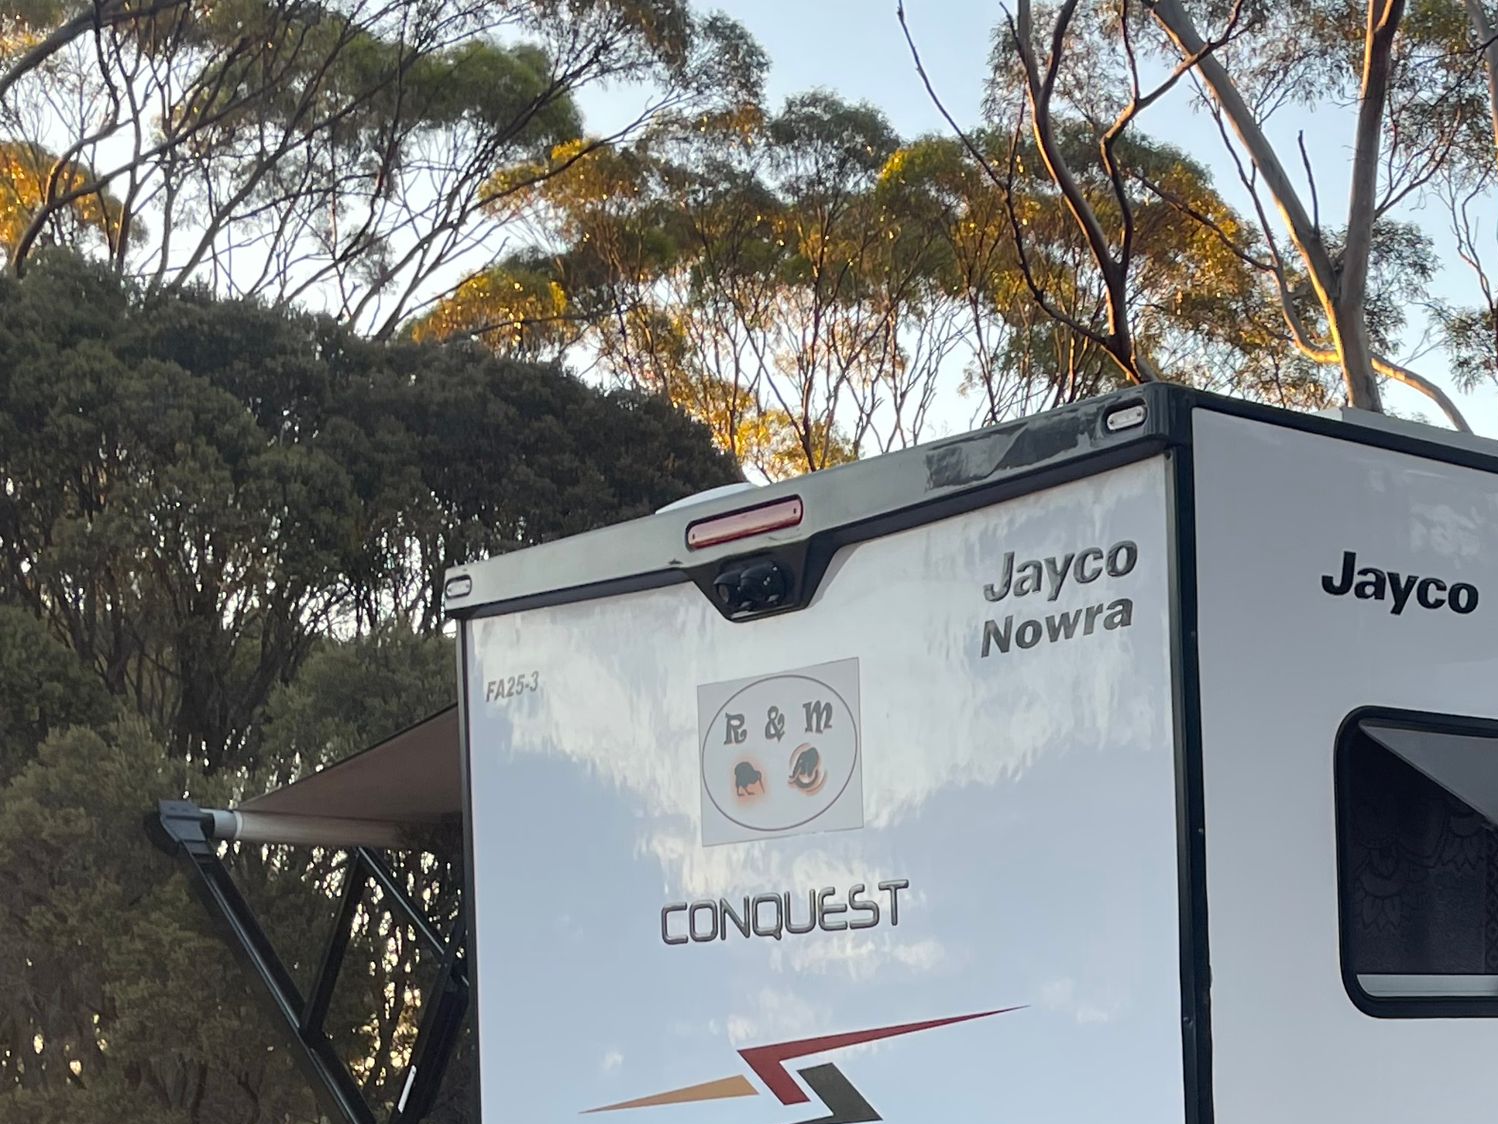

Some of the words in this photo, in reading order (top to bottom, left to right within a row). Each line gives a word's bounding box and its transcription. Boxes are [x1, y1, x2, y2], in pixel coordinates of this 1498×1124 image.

[983, 540, 1139, 602] Jayco
[1321, 550, 1479, 616] Jayco
[981, 598, 1134, 658] Nowra
[486, 670, 539, 703] FA25-3
[724, 712, 748, 745] R
[765, 705, 786, 742] &
[802, 700, 833, 734] M
[661, 879, 909, 945] CONQUEST
